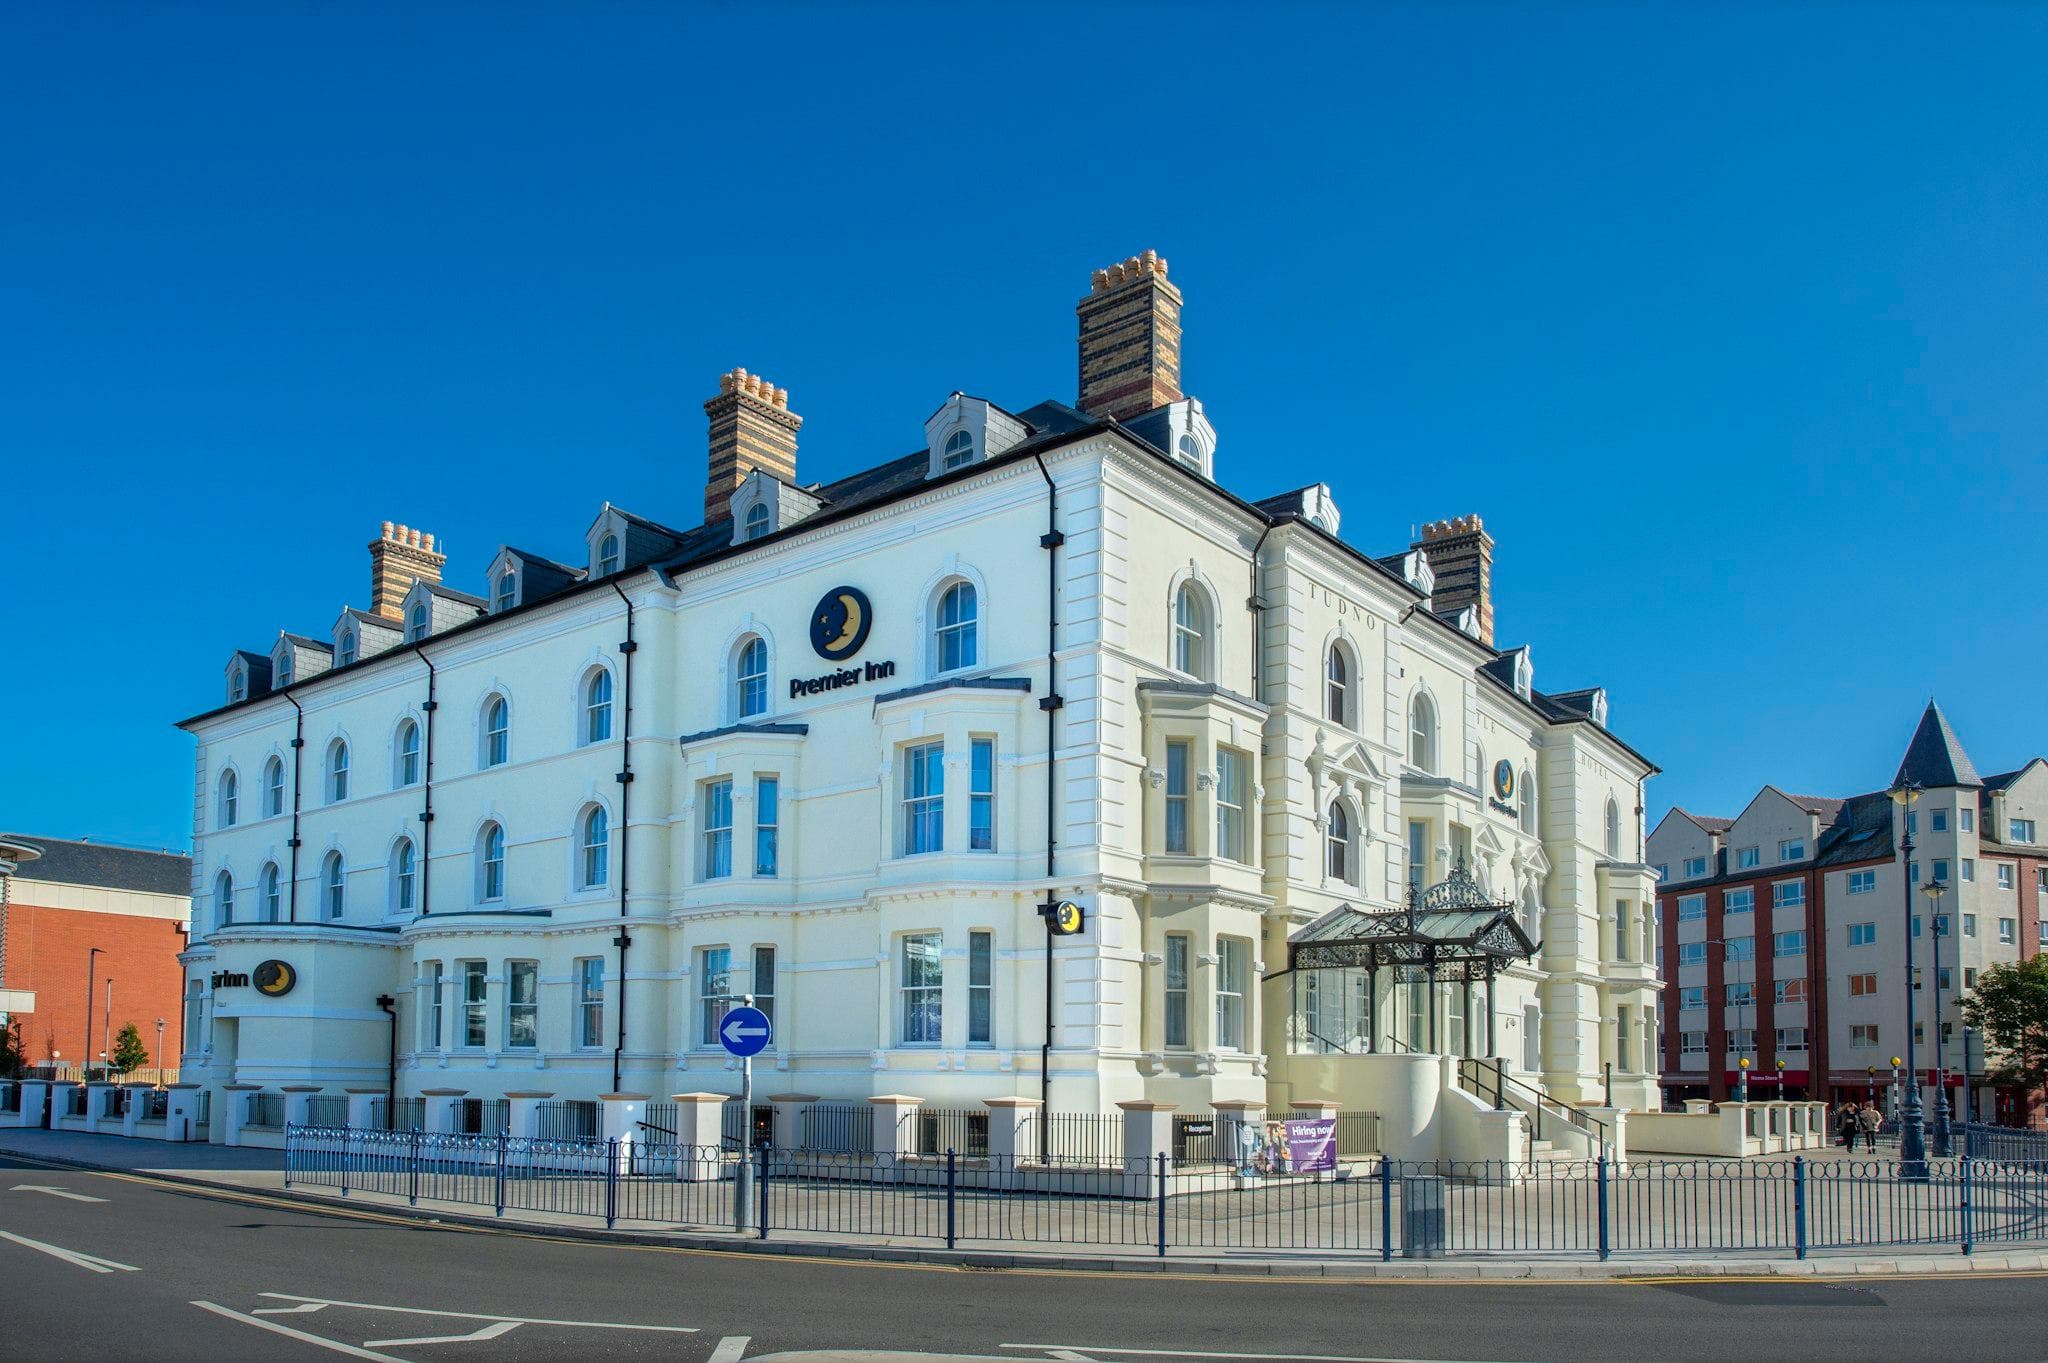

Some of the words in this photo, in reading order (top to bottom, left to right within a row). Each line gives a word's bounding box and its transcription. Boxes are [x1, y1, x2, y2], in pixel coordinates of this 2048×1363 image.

[1309, 582, 1375, 630] TUDNO
[790, 667, 862, 699] Premier
[865, 660, 895, 682] Inn
[223, 969, 249, 987] Inn
[1188, 1124, 1212, 1134] Reception
[1292, 1125, 1316, 1137] Hiring
